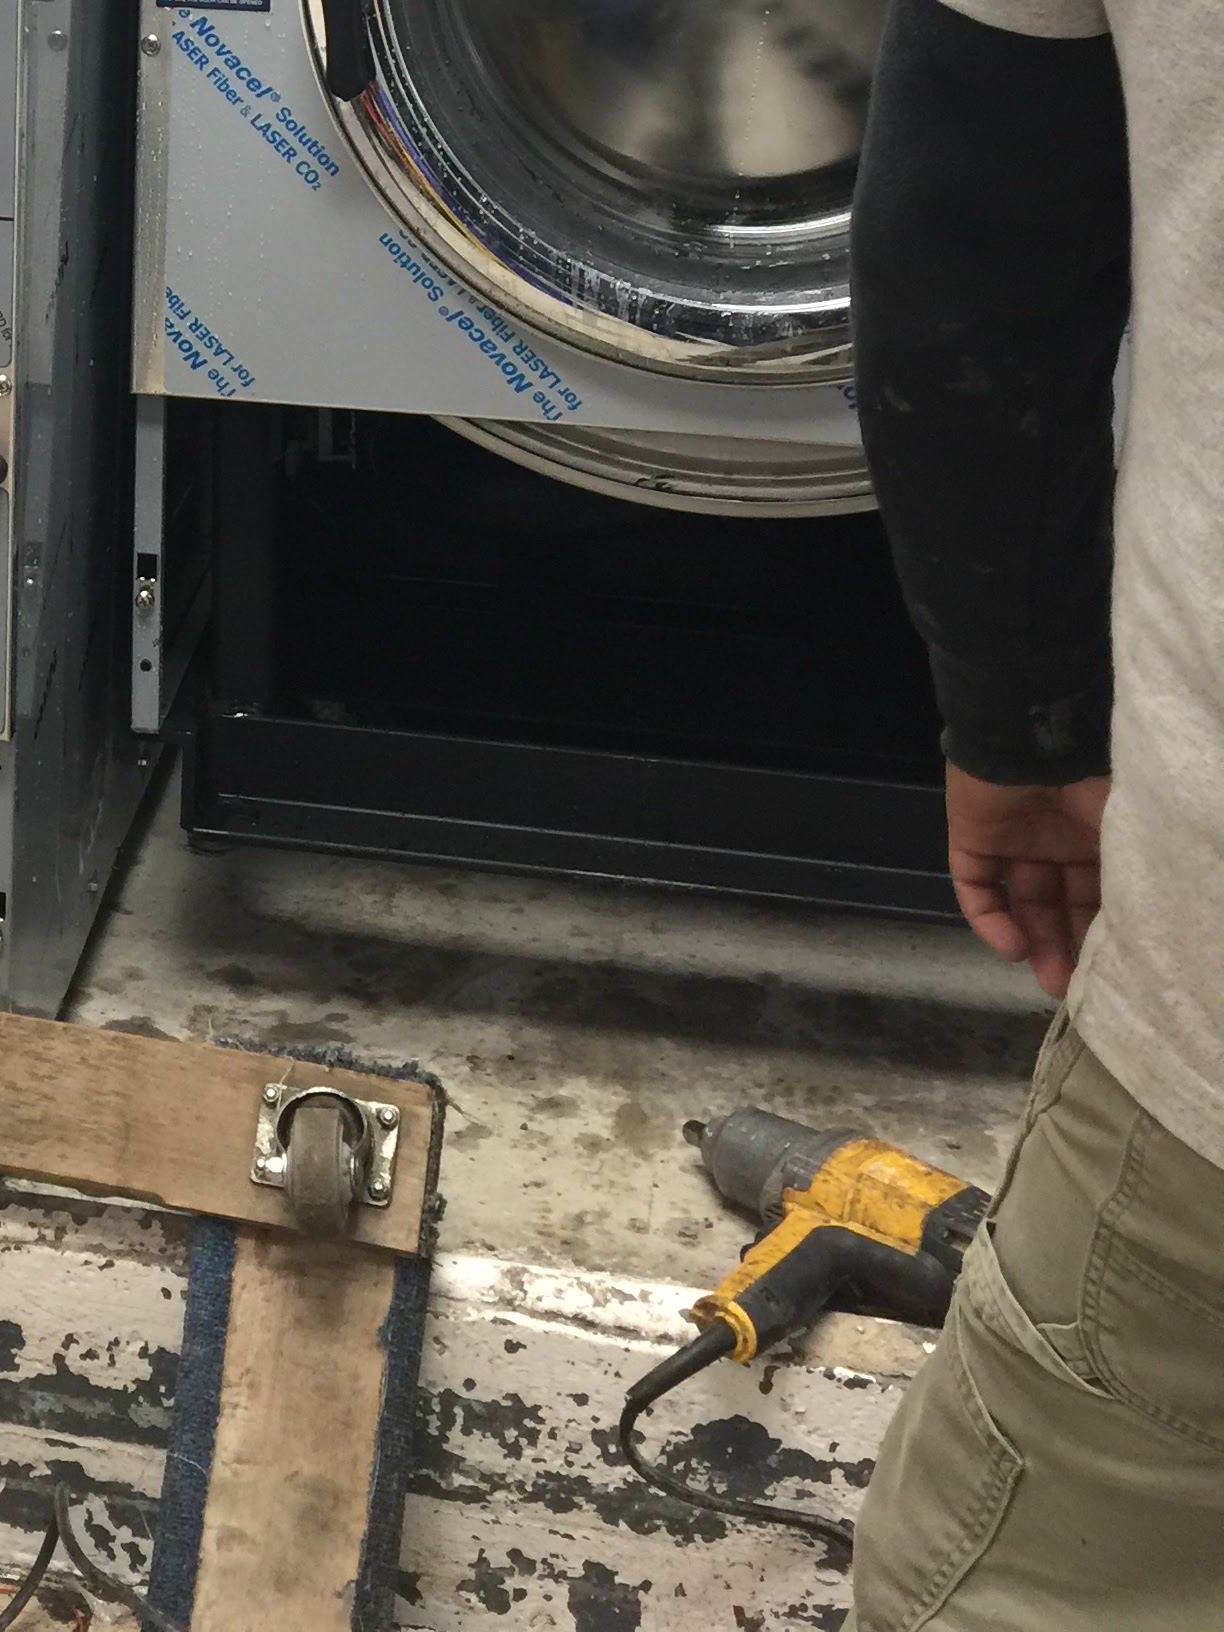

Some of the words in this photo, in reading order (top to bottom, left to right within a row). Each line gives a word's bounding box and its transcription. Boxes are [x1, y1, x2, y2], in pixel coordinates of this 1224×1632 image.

[172, 30, 210, 71] ASER
[206, 66, 245, 106] Fiber
[239, 104, 252, 118] &
[250, 113, 298, 164] LASER
[276, 106, 340, 177] Solution
[378, 233, 444, 302] Solution
[165, 286, 192, 320] Fibe
[475, 304, 516, 343] Fiber
[164, 317, 208, 371] Nova
[188, 316, 235, 366] LASER
[512, 339, 562, 389] LASER
[230, 364, 256, 388] for
[557, 387, 583, 411] for
[532, 390, 564, 422] The
